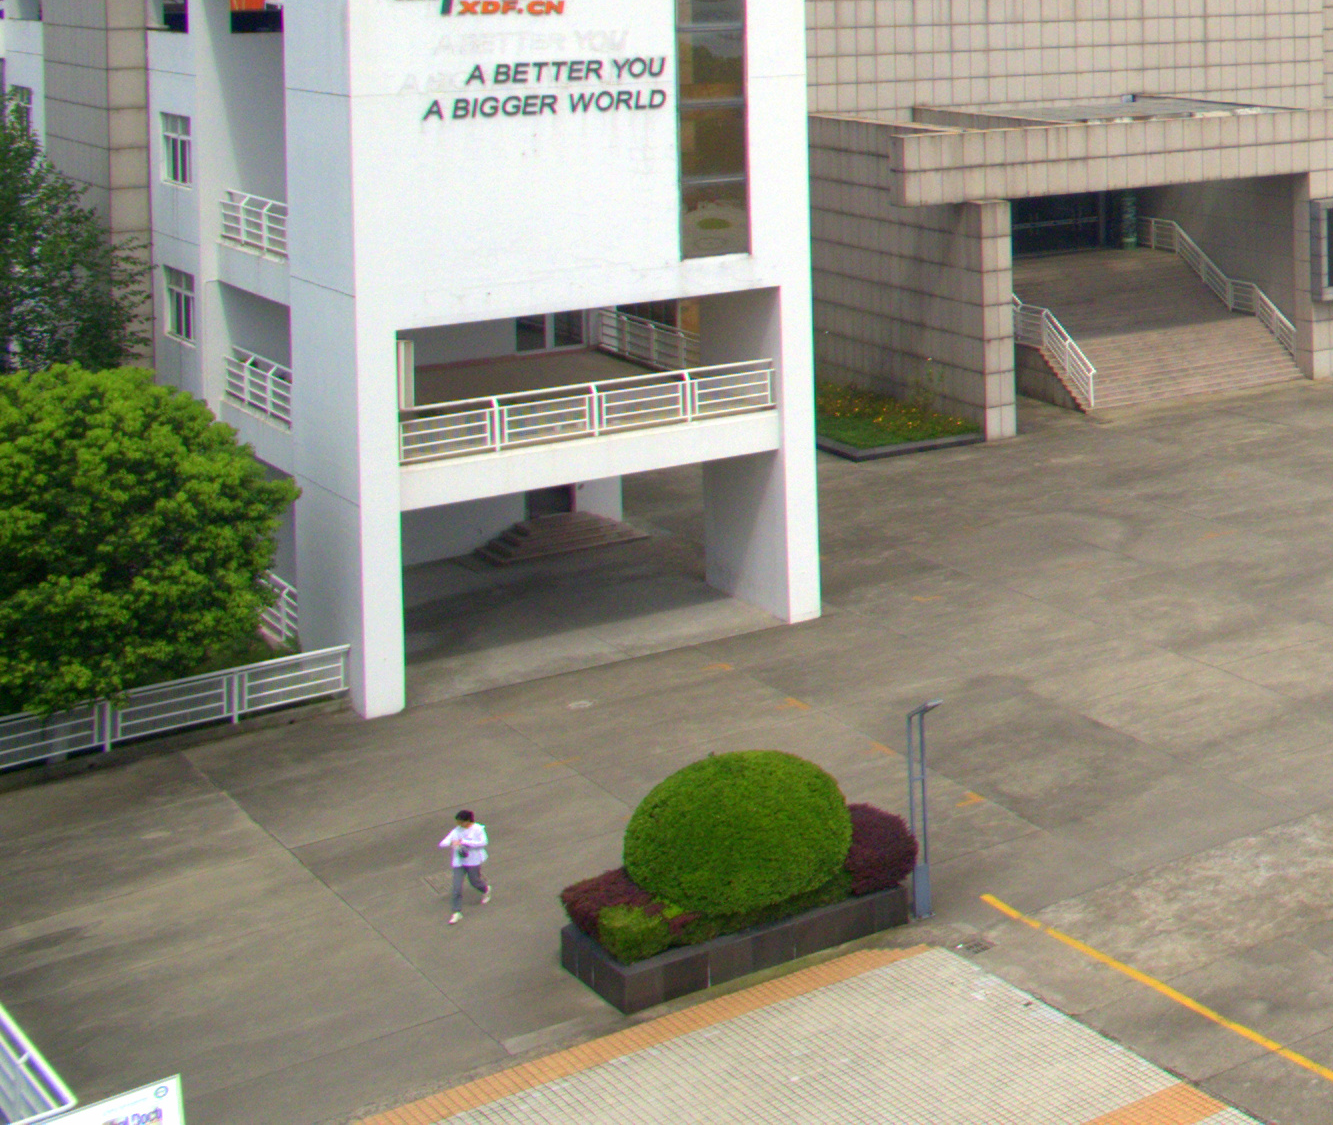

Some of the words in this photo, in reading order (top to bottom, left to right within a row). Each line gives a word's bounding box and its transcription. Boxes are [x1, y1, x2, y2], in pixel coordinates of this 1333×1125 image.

[458, 0, 564, 14] XDF.CN
[465, 64, 485, 85] A
[493, 60, 602, 84] BETTER
[612, 56, 666, 80] YOU
[423, 100, 443, 121] A
[452, 95, 558, 120] BIGGER
[569, 89, 667, 115] WORLD
